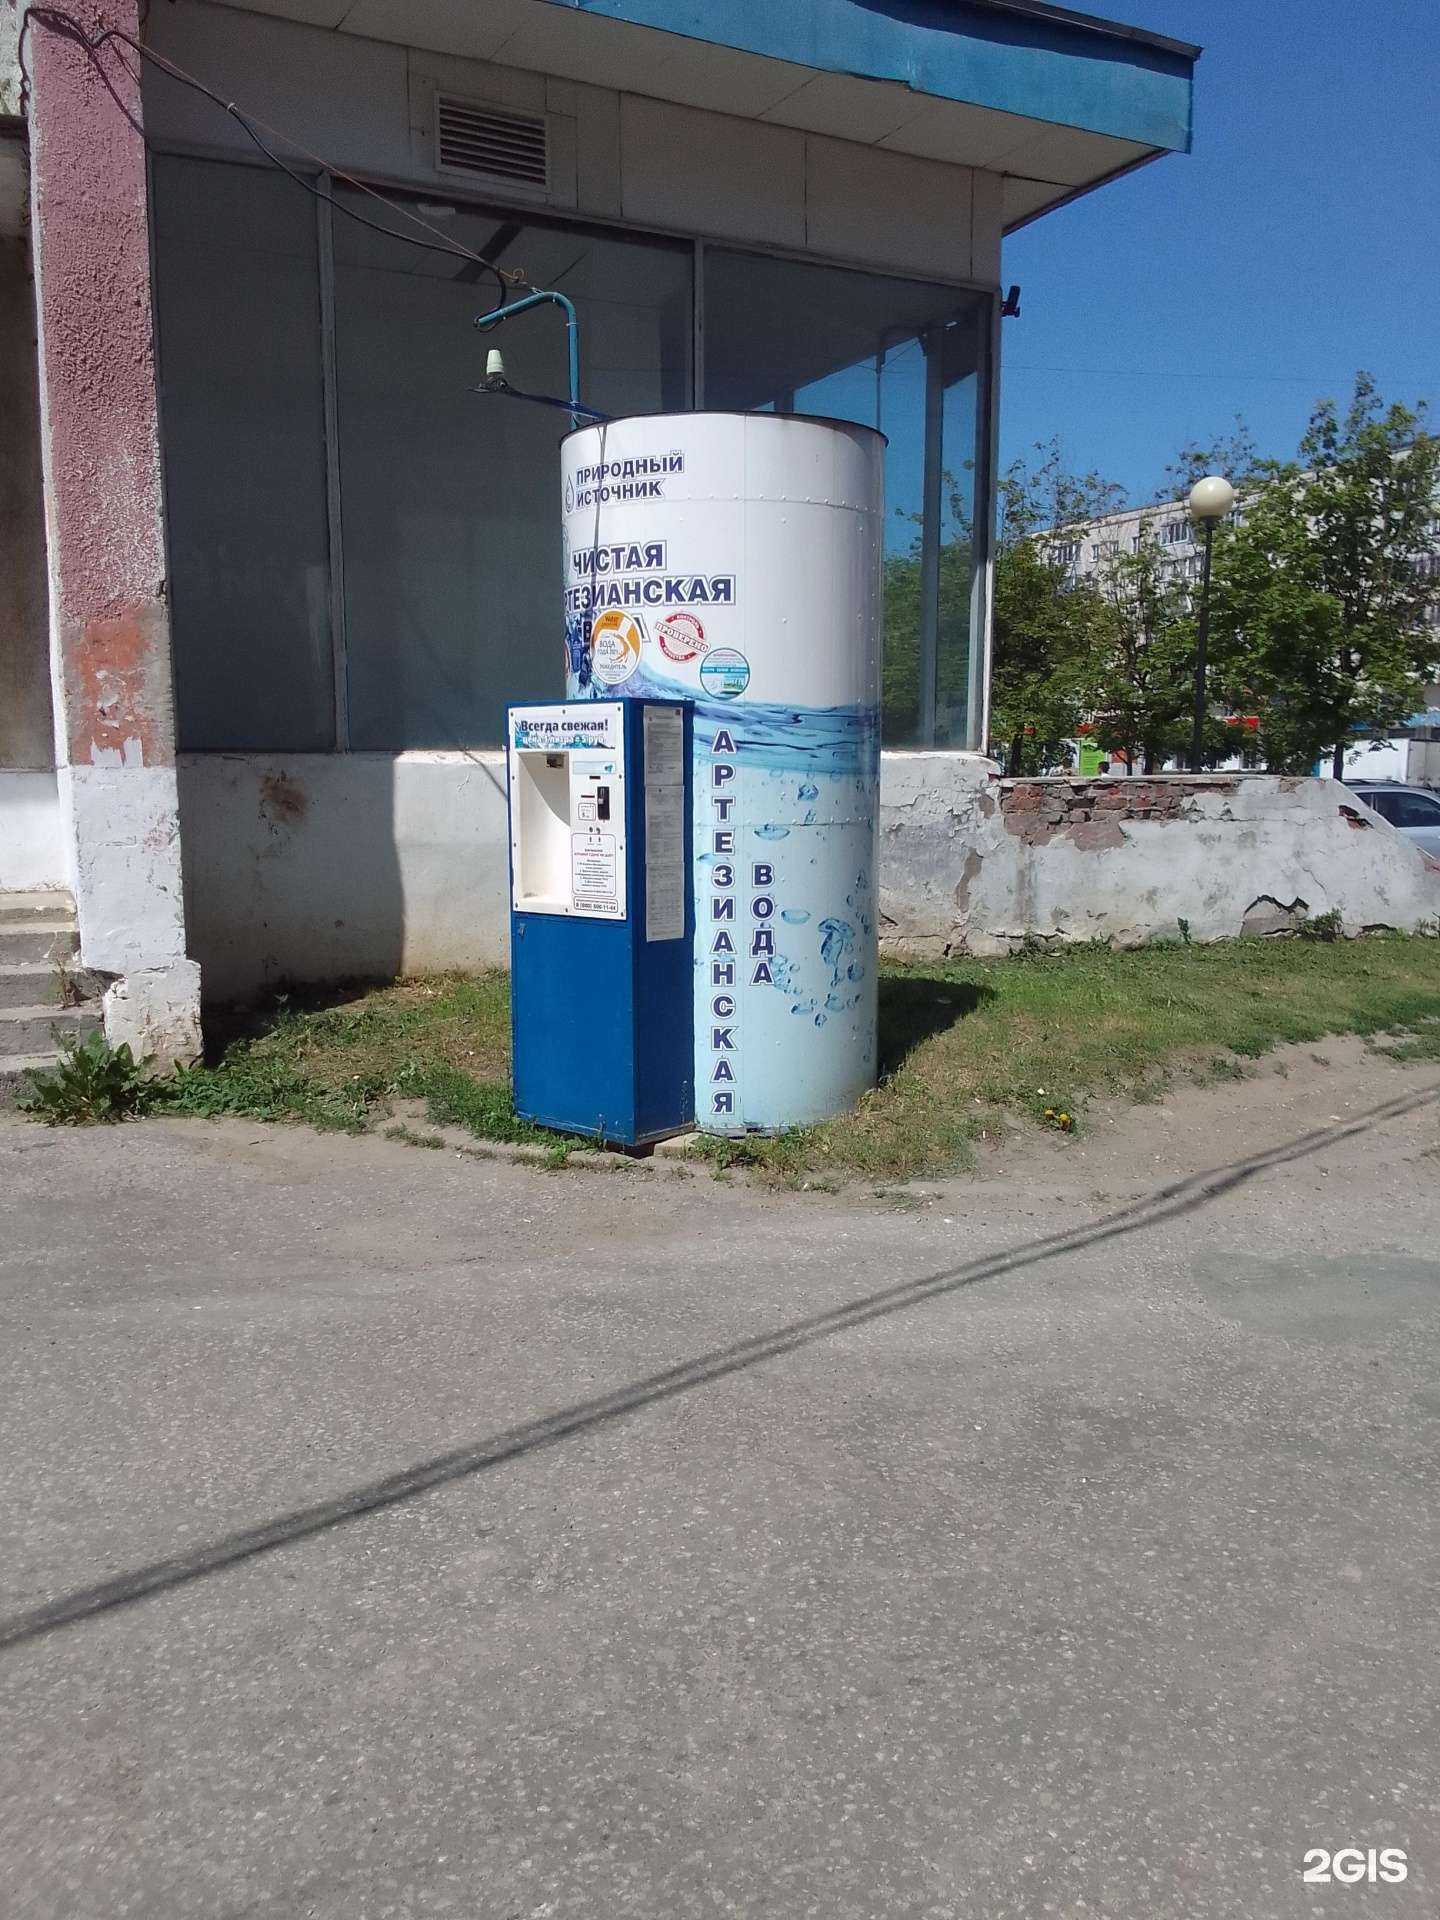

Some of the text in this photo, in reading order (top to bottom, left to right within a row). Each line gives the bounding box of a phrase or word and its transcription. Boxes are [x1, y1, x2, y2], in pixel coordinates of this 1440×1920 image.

[577, 450, 684, 485] ПРИРОДНЫЙ
[577, 480, 663, 507] ИСТОЧНИК
[573, 543, 664, 575] ЧИСТАЯ
[656, 621, 709, 652] ПРОВЕРЕНО
[521, 719, 609, 733] Всегда свежая!
[712, 729, 735, 1115] АРТЕЗИАНСКАЯ
[752, 863, 774, 987] ВОДА
